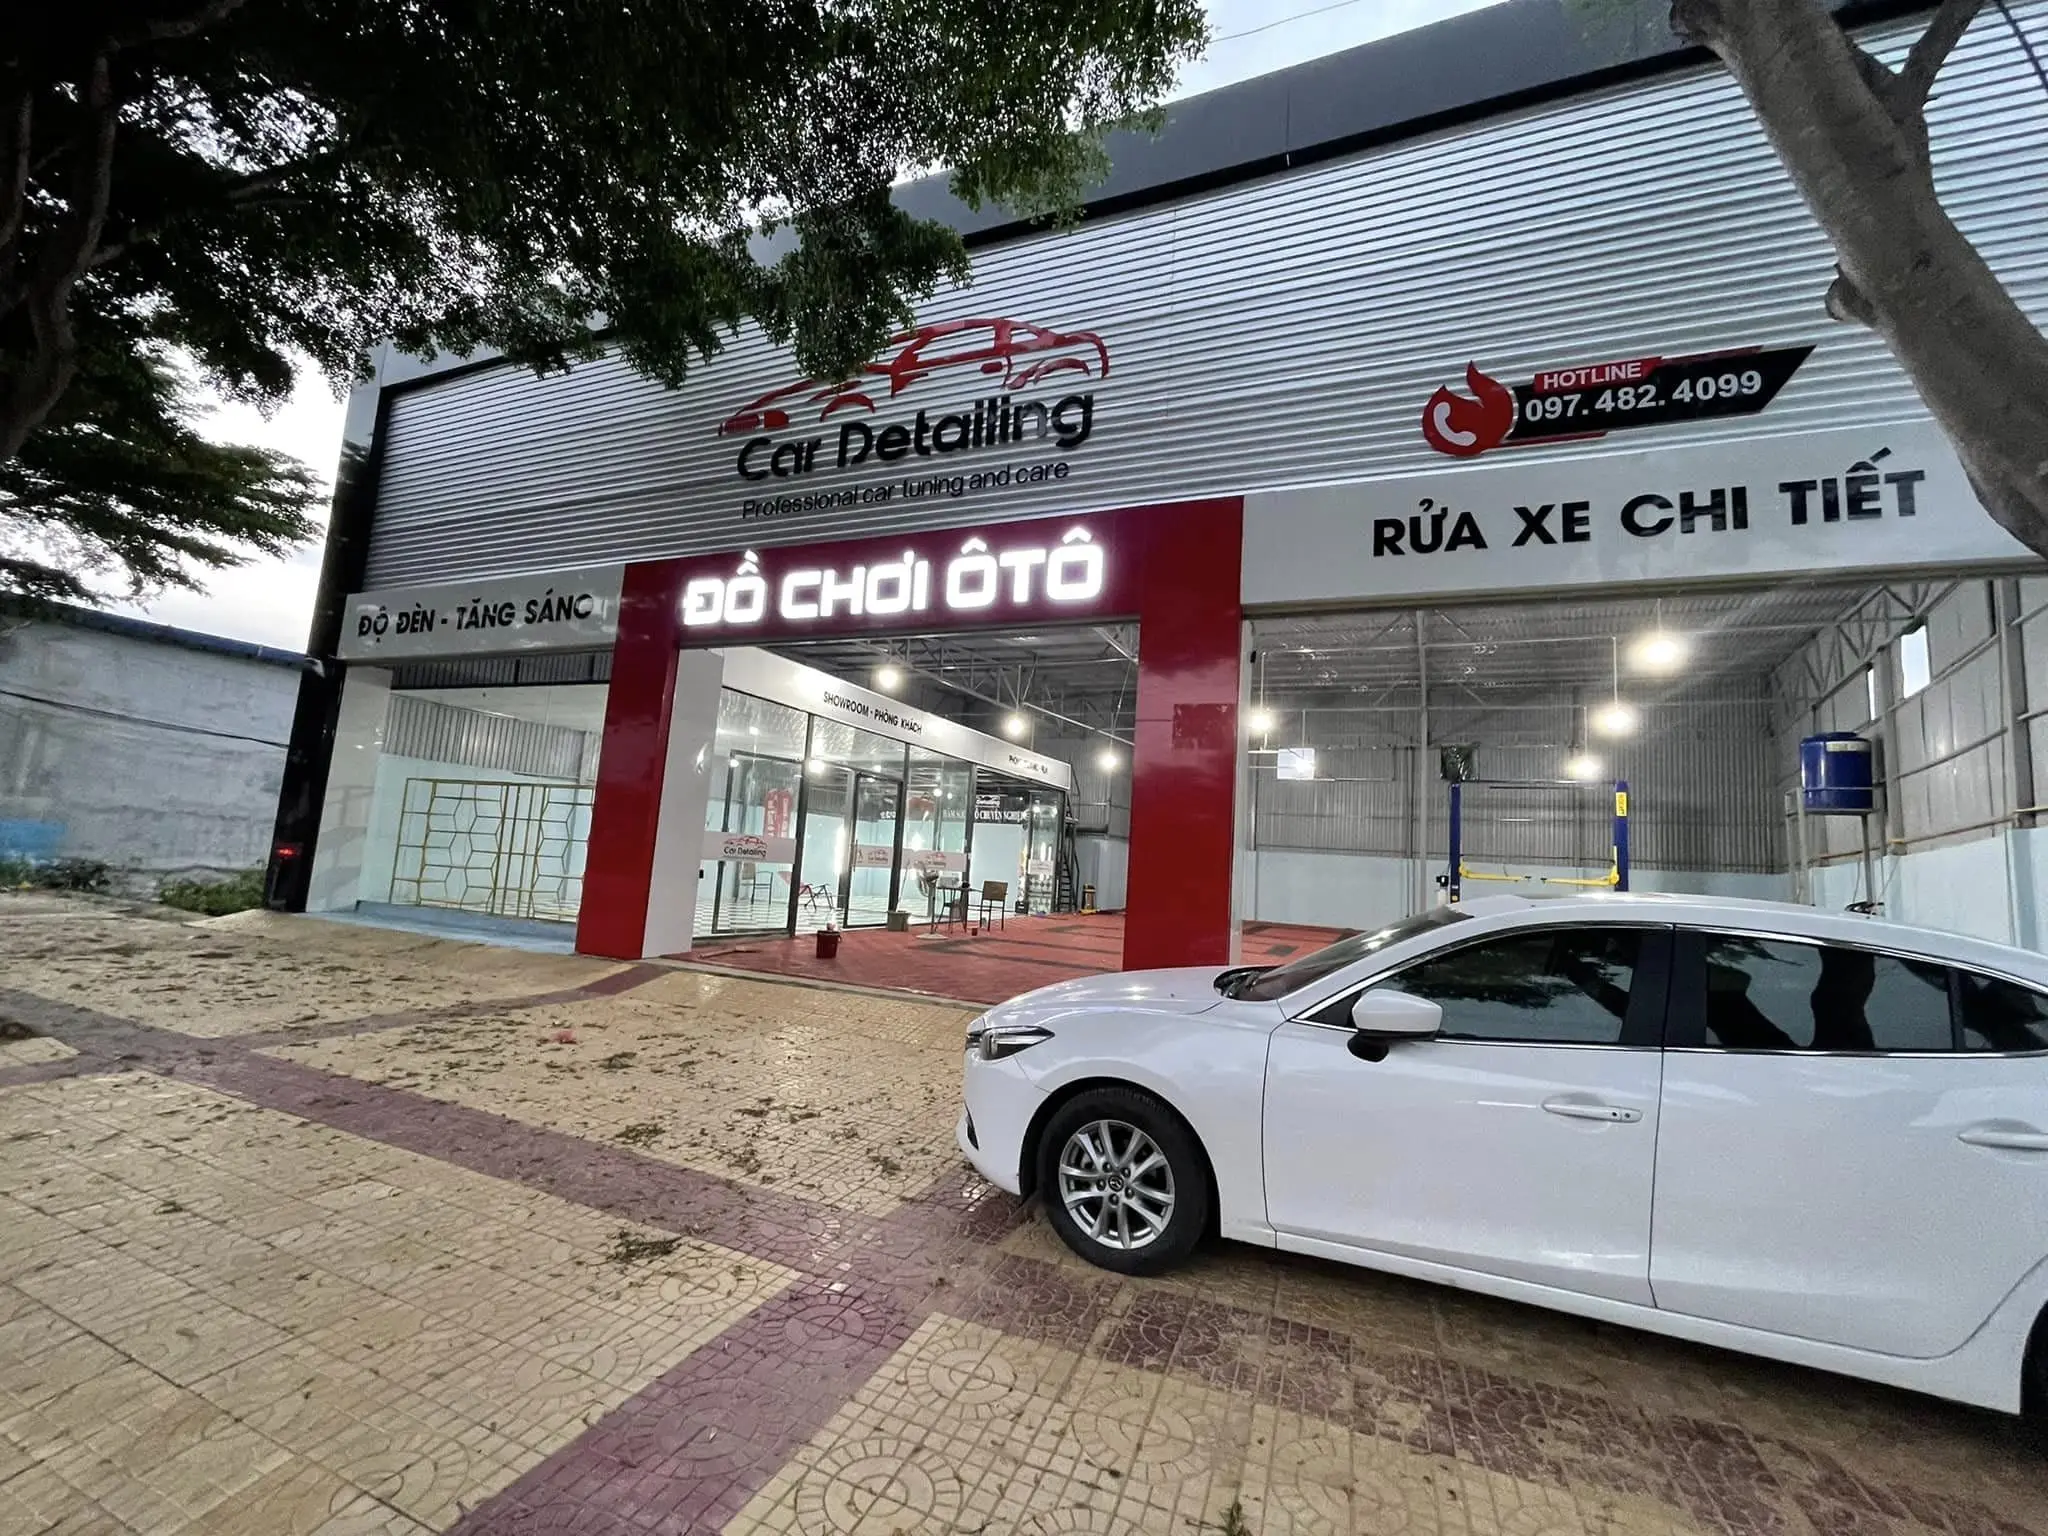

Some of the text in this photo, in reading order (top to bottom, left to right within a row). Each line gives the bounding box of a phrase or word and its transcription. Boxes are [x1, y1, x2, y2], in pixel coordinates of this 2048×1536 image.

[1542, 361, 1642, 390] HOTLINE
[737, 393, 1093, 481] Car Detailing
[741, 460, 1069, 519] Professional car tuning and care
[1373, 446, 1925, 557] RỬA XE CHI TIẾT
[683, 525, 1105, 626] ĐỒ CHƠI ÔTÔ
[358, 606, 389, 643] ĐỘ
[396, 602, 436, 635] ĐÈN
[456, 598, 516, 630] TĂNG
[823, 691, 869, 717] SHOWROOM
[723, 846, 737, 855] Car
